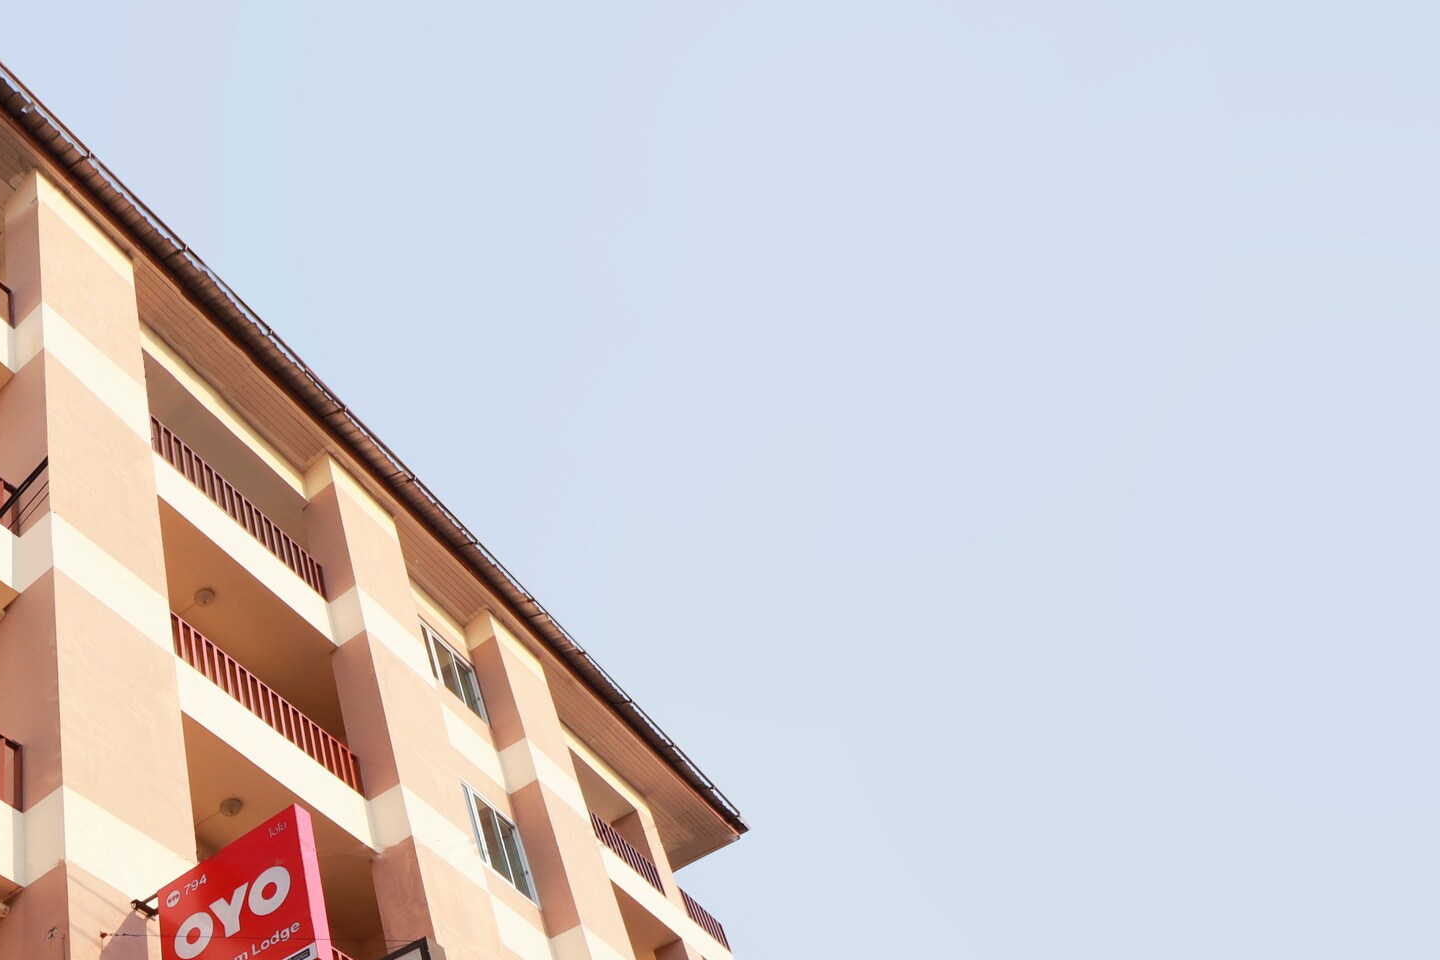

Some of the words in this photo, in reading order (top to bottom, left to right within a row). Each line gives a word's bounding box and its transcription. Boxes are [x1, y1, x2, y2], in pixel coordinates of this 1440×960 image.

[184, 874, 207, 896] 794
[174, 865, 291, 960] OYO
[251, 921, 301, 956] Lodge
